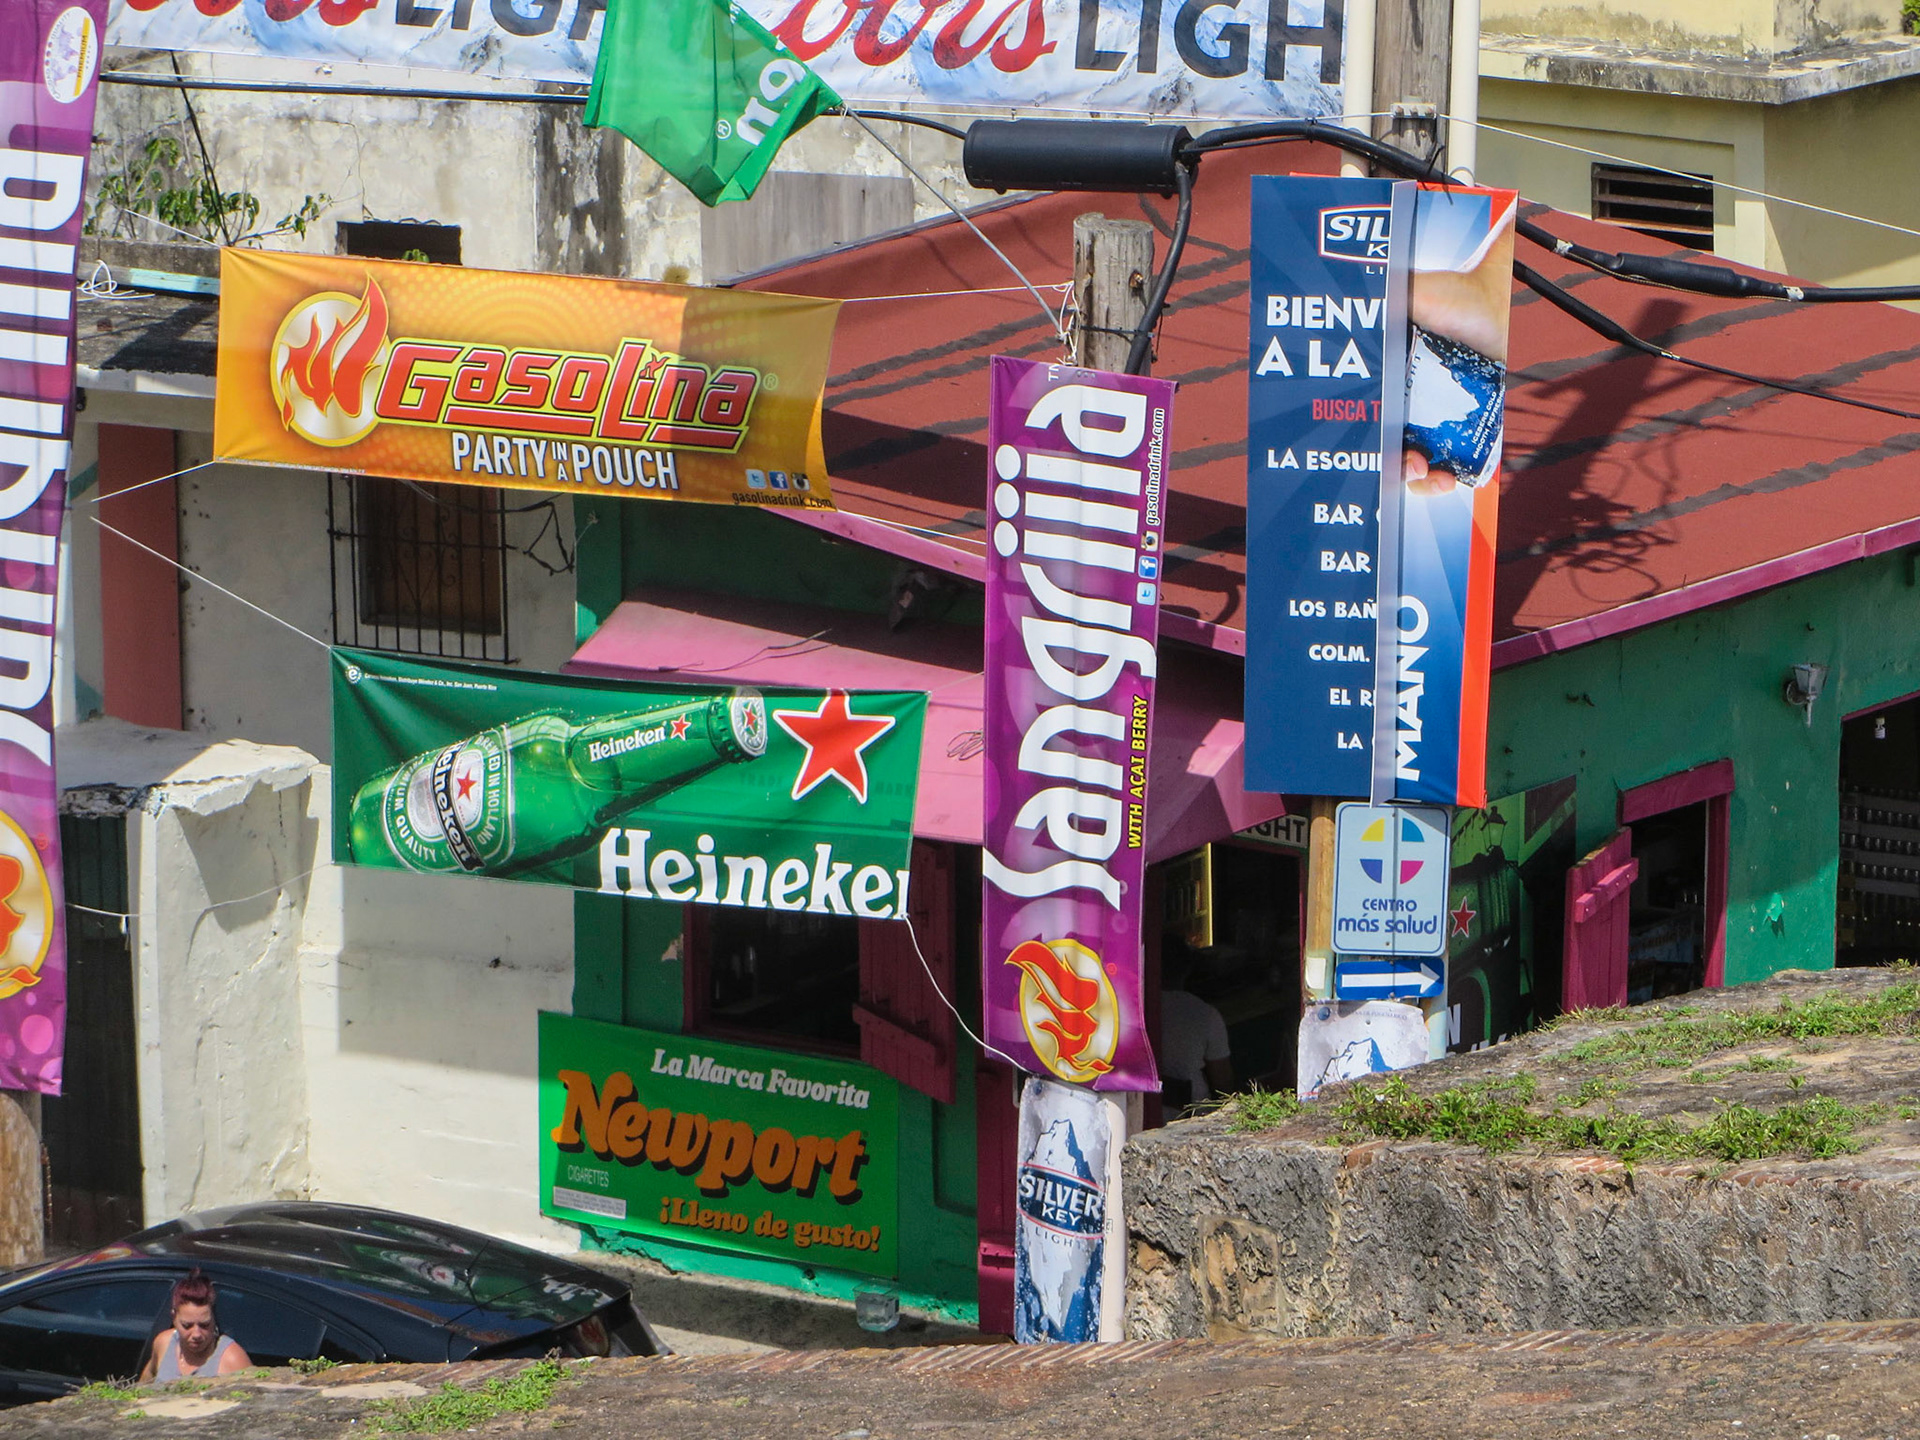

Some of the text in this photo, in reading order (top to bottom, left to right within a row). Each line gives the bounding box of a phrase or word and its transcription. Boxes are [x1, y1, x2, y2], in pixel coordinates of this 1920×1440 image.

[767, 0, 1344, 84] oors LIGH
[77, 35, 88, 79] PREMIUM
[1326, 215, 1390, 241] SIL
[1366, 243, 1389, 257] K
[1366, 265, 1384, 275] LI
[1266, 294, 1386, 332] BIENV
[1255, 335, 1371, 380] A LA
[1312, 398, 1382, 422] BUSCA T
[1472, 391, 1497, 444] ICEBERG COLD
[1472, 428, 1490, 459] SMOOTH
[452, 431, 679, 490] PARTY IN POUCH
[1145, 408, 1165, 525] gasolinadrink.com
[1267, 447, 1300, 469] LA
[557, 463, 569, 481] A
[731, 492, 832, 508] gasolinadrink.com
[1314, 503, 1365, 526] BAR
[1320, 550, 1372, 574] BAR
[1289, 598, 1378, 619] LOS BAÑ
[1308, 644, 1371, 663] COLM.
[1329, 687, 1376, 707] EL R
[588, 727, 666, 763] Heineken
[1337, 732, 1364, 750] LA
[1128, 695, 1148, 849] WITH AÇAI BERRY
[474, 735, 501, 846] BREWED IN HOLLAND
[395, 815, 437, 863] QUALITY
[1362, 898, 1418, 912] CENTRO
[1338, 913, 1438, 934] más salud
[650, 1048, 870, 1109] La Marca Favorita
[551, 1069, 868, 1204] Newport
[566, 1164, 610, 1188] CIGARETTES
[1019, 1173, 1101, 1221] SILVER
[658, 1196, 749, 1233] ¡Lleno
[753, 1210, 789, 1239] de
[793, 1221, 881, 1252] gusto!
[1041, 1203, 1082, 1227] KEY
